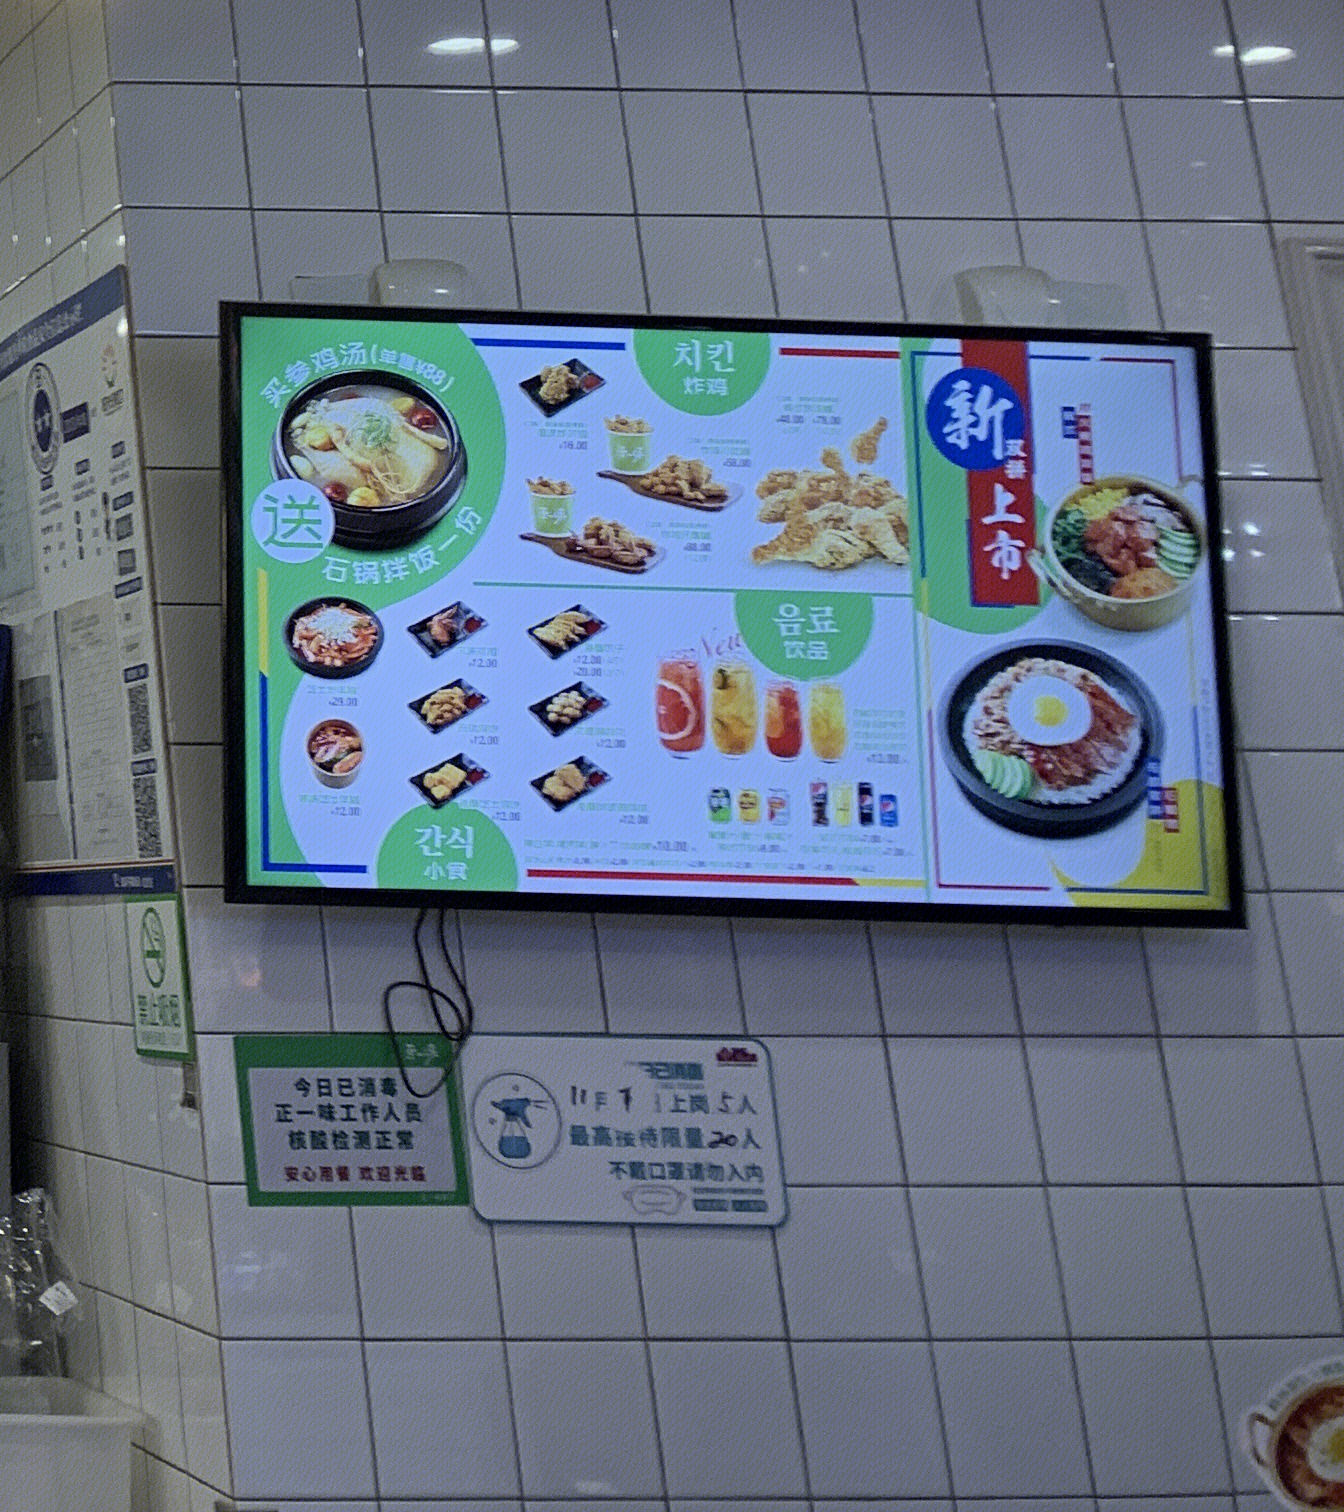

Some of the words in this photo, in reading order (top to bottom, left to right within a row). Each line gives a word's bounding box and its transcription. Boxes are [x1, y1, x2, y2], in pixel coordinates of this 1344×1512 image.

[672, 338, 737, 374] 치킨
[681, 375, 730, 397] 炸鸡
[942, 379, 1015, 461] 新
[262, 493, 324, 549] 送
[981, 482, 1026, 580] 上市
[321, 505, 483, 585] 石锅拌饭一份
[772, 603, 841, 638] 음료
[783, 640, 831, 661] 饮品
[413, 823, 475, 860] 간식
[293, 1076, 398, 1098] 今日已消毒
[274, 1102, 423, 1123] 正一味工作人员
[287, 1129, 414, 1151] 核酸检测正常
[284, 1165, 351, 1183] 安心用餐
[358, 1165, 427, 1183] 欢迎光临
[608, 1160, 765, 1182] 不戴口罩请勿入内
